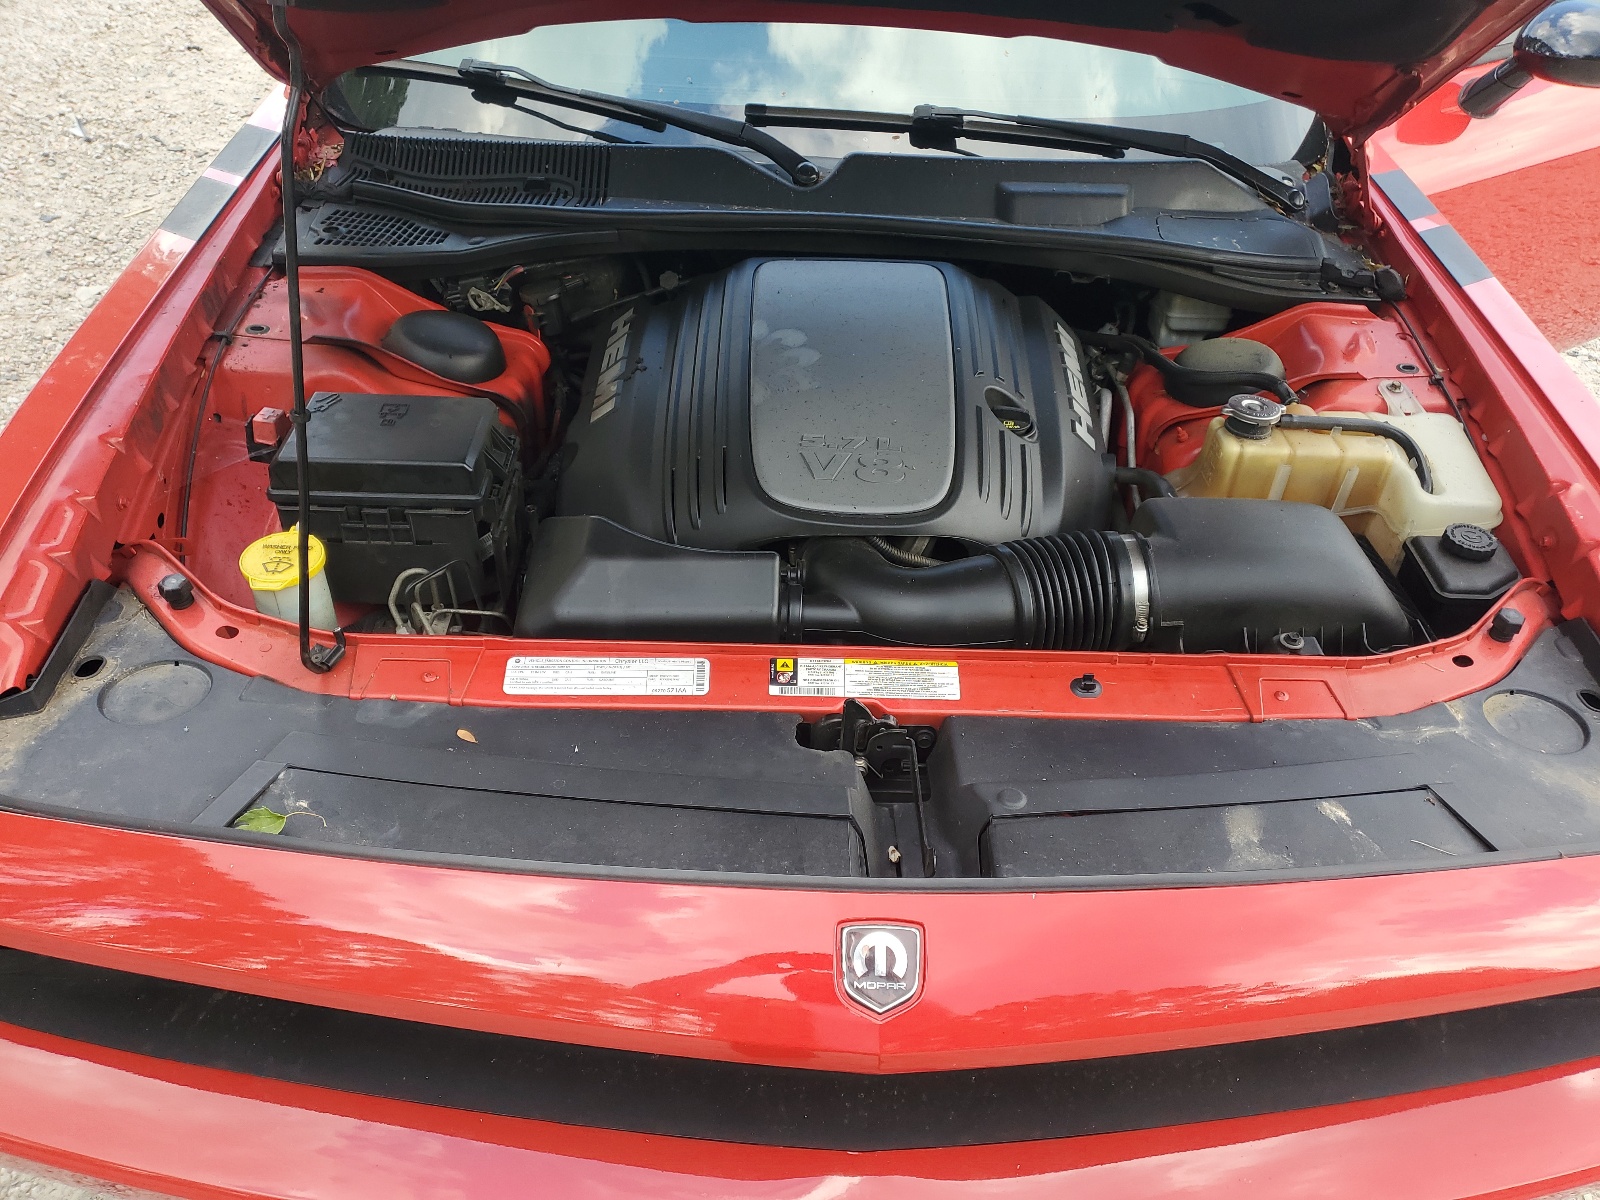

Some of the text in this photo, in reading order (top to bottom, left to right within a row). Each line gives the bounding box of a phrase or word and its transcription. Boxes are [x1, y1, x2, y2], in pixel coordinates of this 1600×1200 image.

[589, 307, 634, 424] HEMI
[1056, 321, 1096, 451] HEMI
[799, 434, 904, 453] 5.7L
[799, 451, 909, 484] V8
[853, 980, 907, 990] MOPAR
